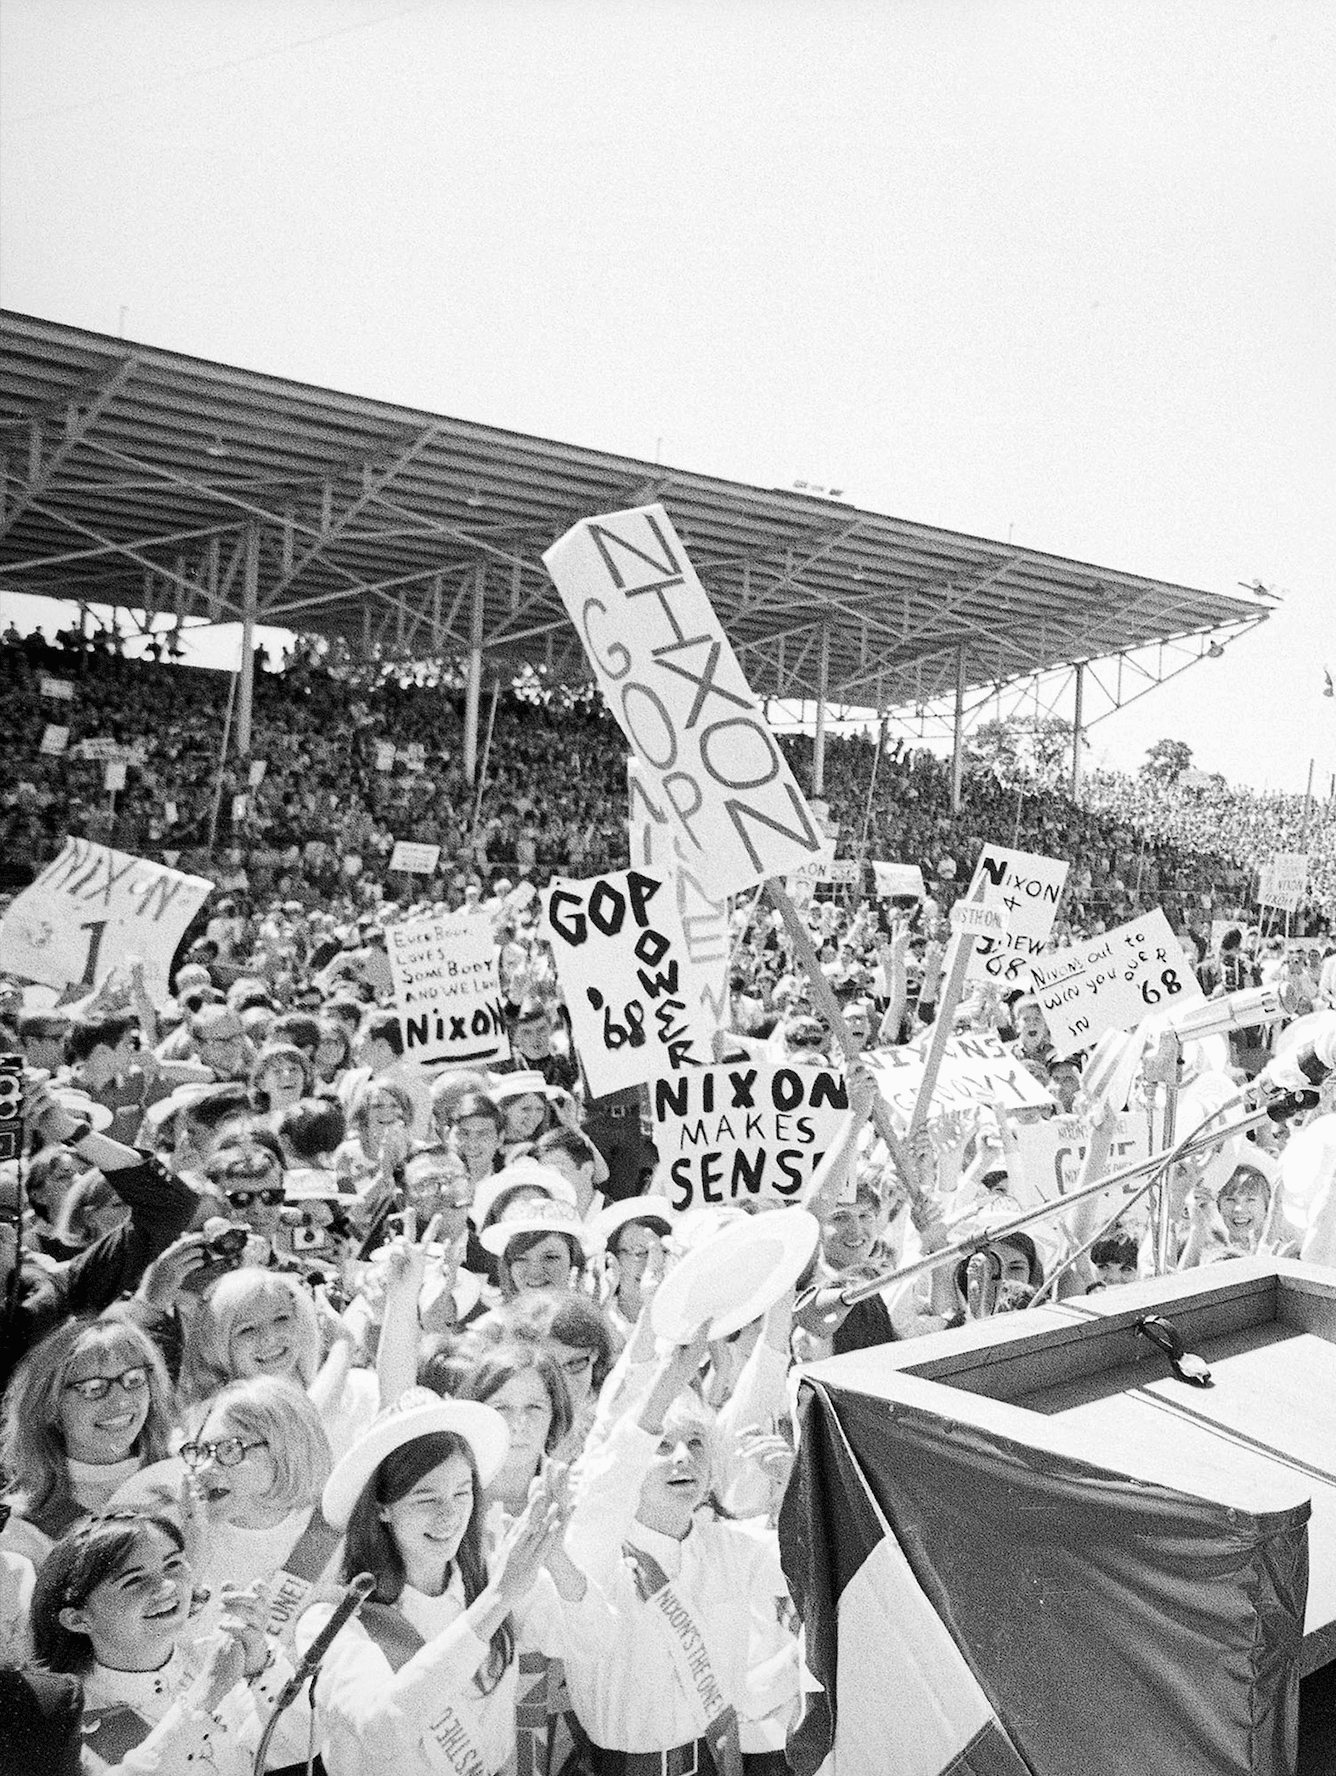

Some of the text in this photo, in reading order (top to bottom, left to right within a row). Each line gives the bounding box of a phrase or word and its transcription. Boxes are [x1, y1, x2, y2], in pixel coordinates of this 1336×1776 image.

[582, 597, 704, 852] GOP
[588, 513, 820, 873] NIXON
[550, 871, 662, 947] GOP
[982, 857, 1060, 904] NIXON
[1125, 933, 1145, 948] to
[1136, 969, 1181, 1004] '68
[587, 987, 646, 1050] '68
[656, 1069, 849, 1122] NIXON
[680, 1113, 816, 1150] MAKES
[670, 1147, 826, 1211] SENS
[659, 1588, 701, 1651] NIXON'S
[688, 1643, 711, 1682] THE
